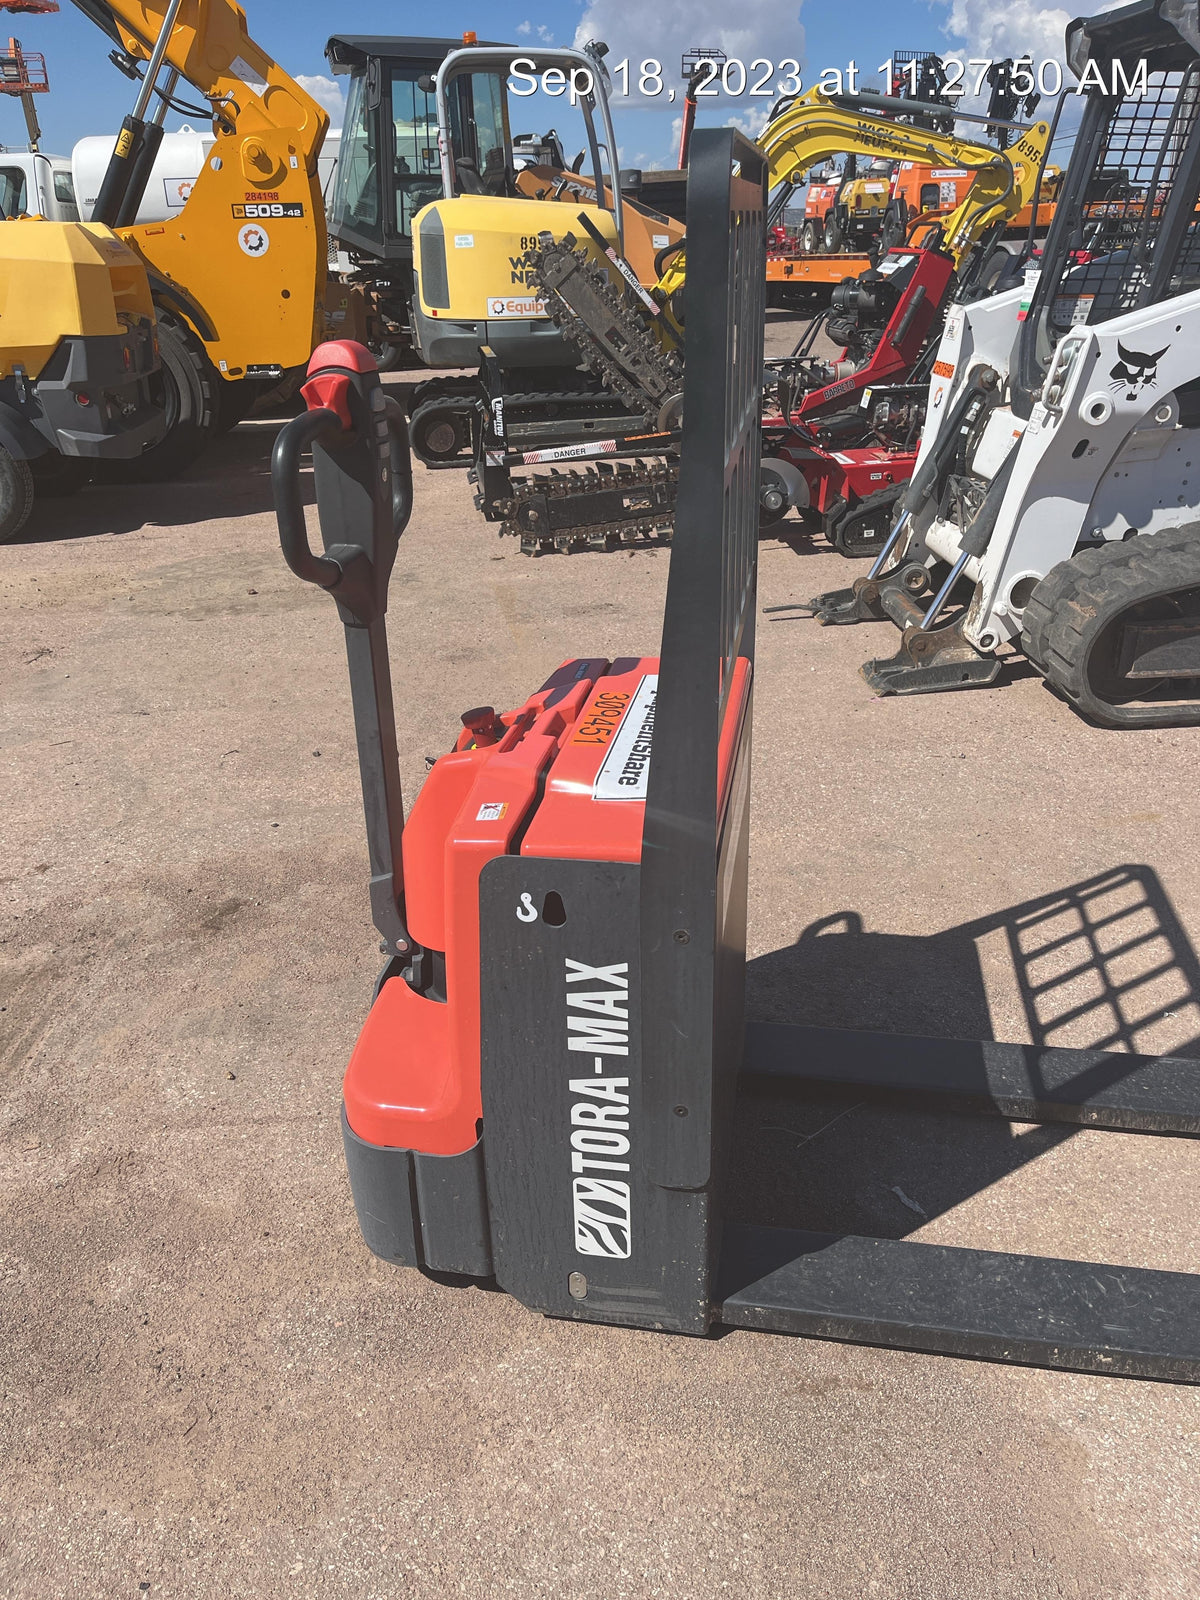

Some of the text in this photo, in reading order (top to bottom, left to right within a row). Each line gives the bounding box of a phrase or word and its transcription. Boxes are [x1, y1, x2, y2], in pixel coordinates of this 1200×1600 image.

[245, 192, 279, 201] 284198
[623, 269, 644, 294] DANGER
[823, 378, 855, 401] BARRETO
[553, 447, 587, 459] DANGER
[573, 692, 630, 744] 309451
[565, 957, 631, 1173] TORA-MAX
